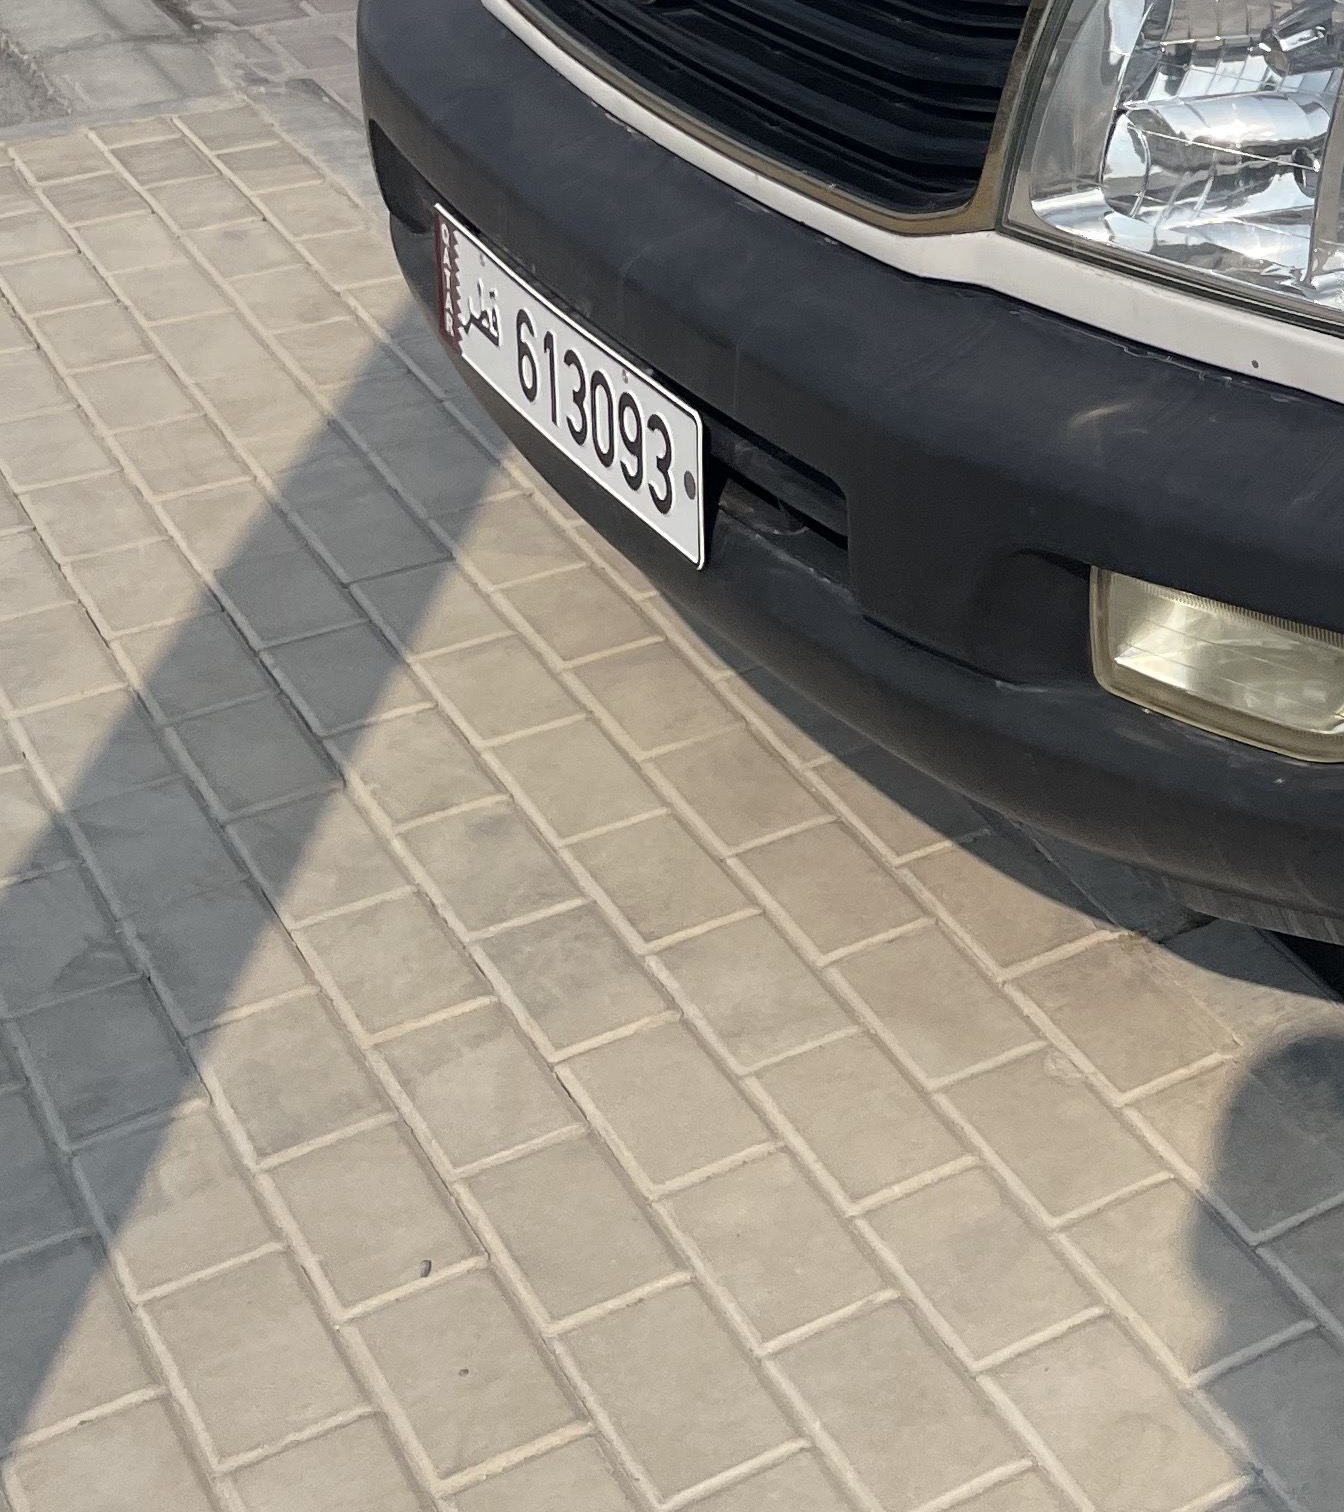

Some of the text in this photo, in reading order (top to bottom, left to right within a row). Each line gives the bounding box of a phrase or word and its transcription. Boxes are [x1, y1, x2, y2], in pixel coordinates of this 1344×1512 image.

[441, 223, 455, 338] QATAR
[461, 277, 504, 349] قطر
[515, 307, 676, 516] 613093
